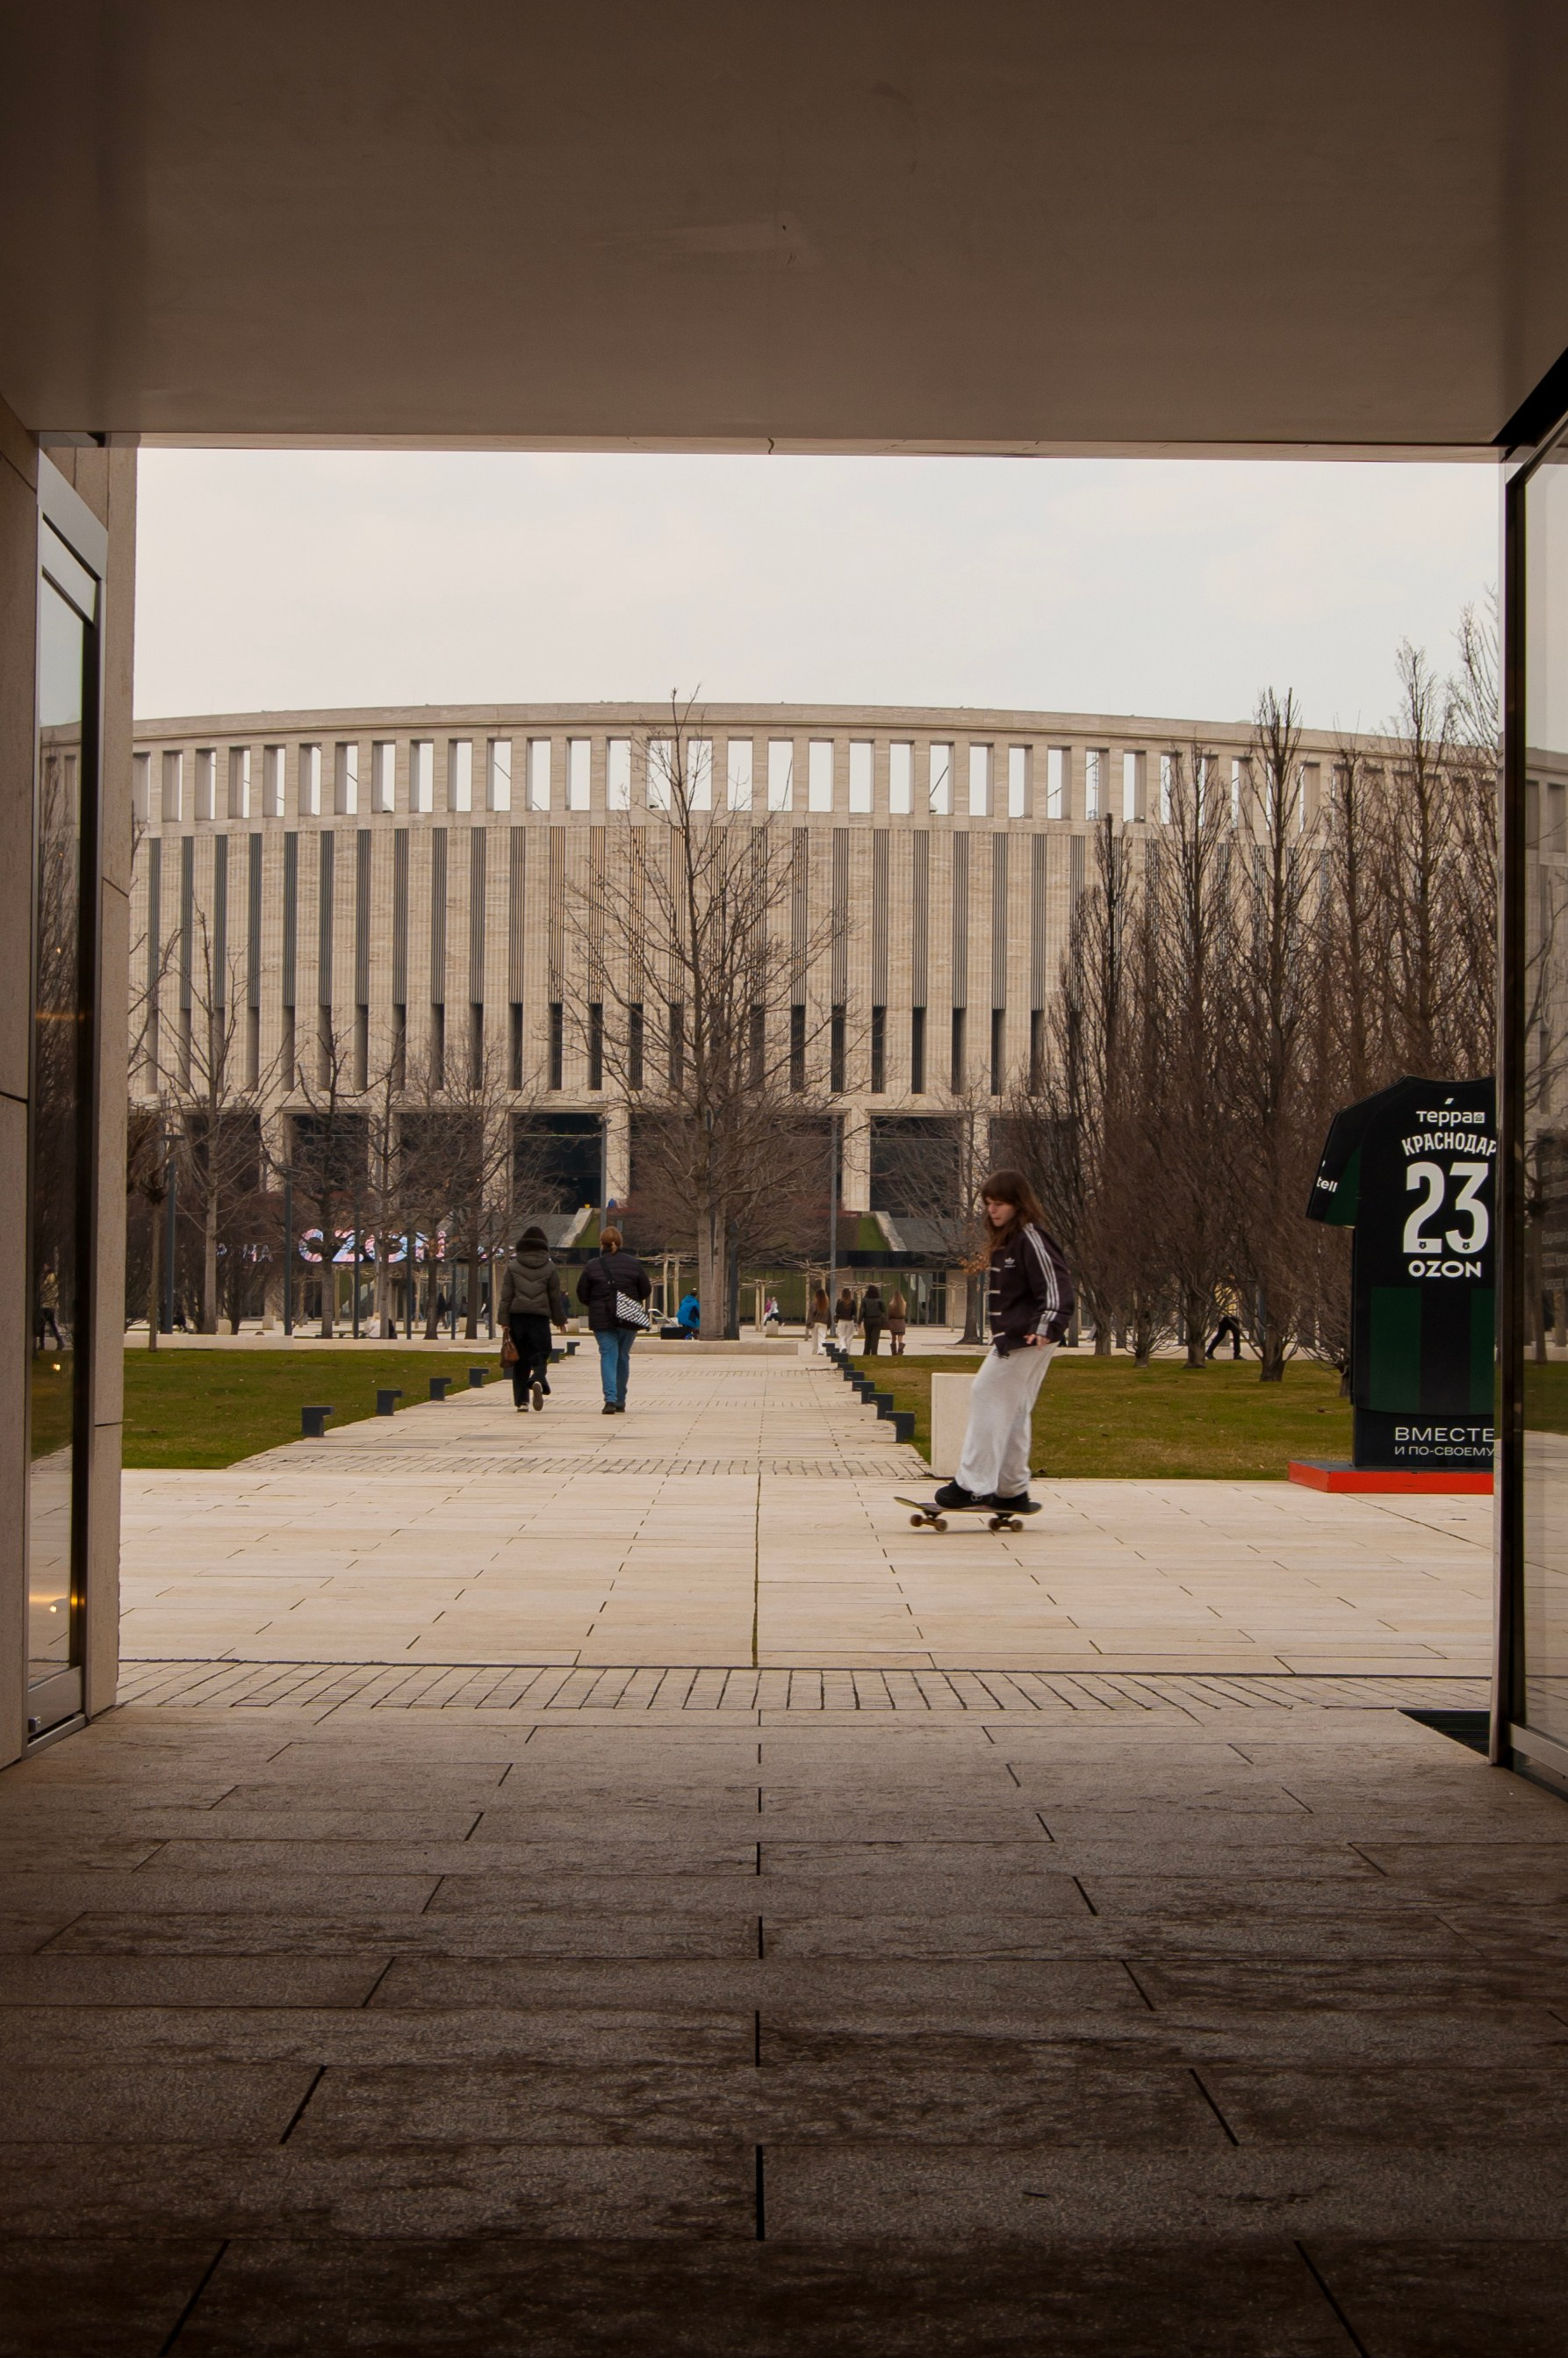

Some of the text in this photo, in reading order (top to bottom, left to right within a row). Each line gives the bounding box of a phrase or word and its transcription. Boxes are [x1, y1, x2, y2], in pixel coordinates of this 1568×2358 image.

[1401, 1132, 1497, 1157] КРАСНОДАР
[1403, 1161, 1490, 1254] 23
[1407, 1260, 1482, 1278] OZON
[1394, 1427, 1495, 1442] ВМЕСТЕ
[1394, 1445, 1495, 1457] И ПО-СВОЕМУ
